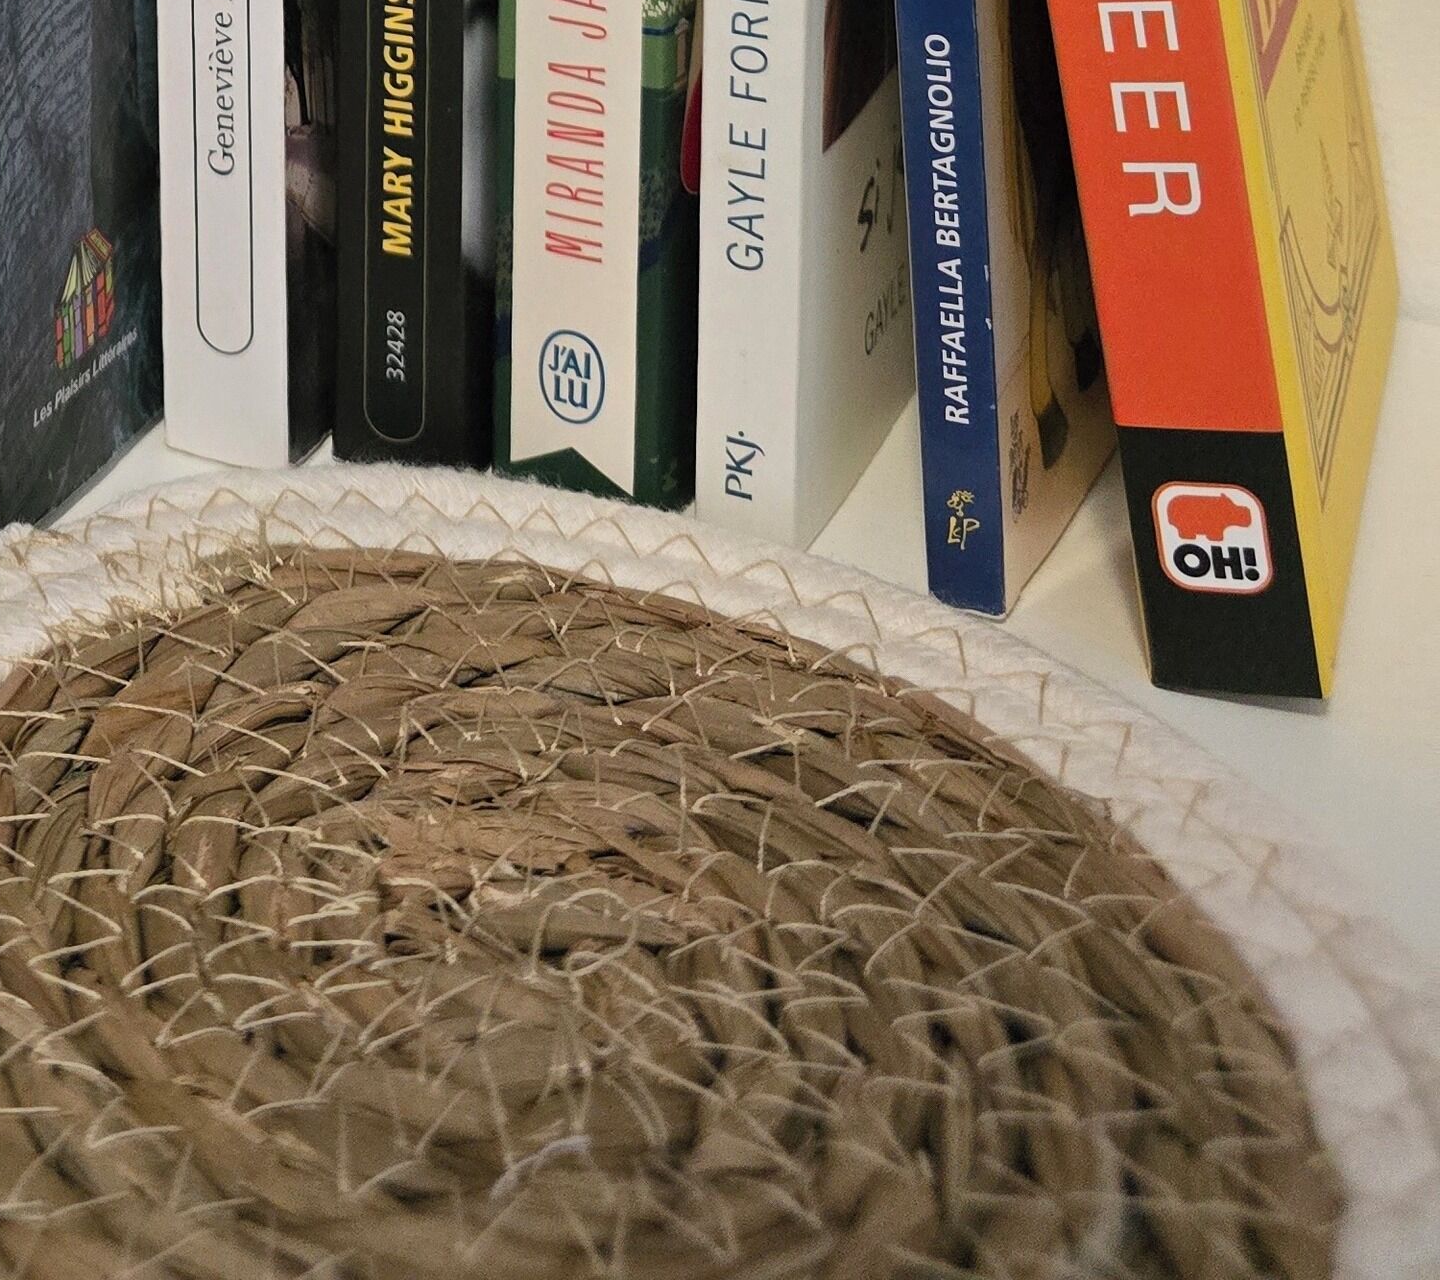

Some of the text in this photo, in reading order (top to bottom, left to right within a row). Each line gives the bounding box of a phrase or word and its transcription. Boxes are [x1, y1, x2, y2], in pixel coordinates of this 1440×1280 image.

[207, 10, 235, 177] Geneviève
[382, 146, 414, 257] MARY
[544, 60, 608, 264] MIRANDA
[725, 123, 767, 274] GAYLE
[924, 33, 970, 425] RAFFAELLA BERTAGNOLIO
[385, 310, 406, 383] 32428
[548, 344, 592, 380] J'AI
[554, 374, 589, 410] LU
[32, 400, 53, 428] Les
[54, 368, 91, 410] Plaisirs
[1172, 543, 1261, 582] OH!
